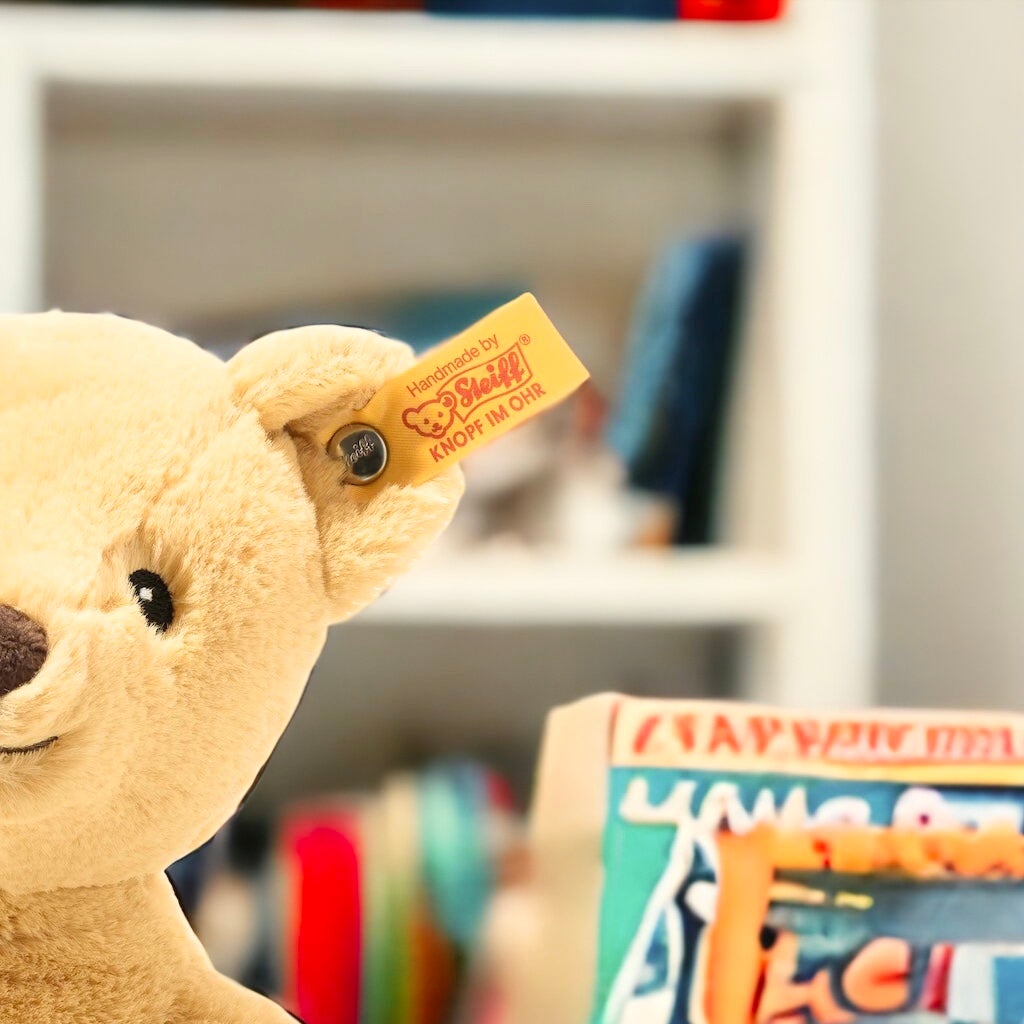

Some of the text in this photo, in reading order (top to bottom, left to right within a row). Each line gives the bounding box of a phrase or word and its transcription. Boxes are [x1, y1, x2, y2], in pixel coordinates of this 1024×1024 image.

[406, 334, 499, 397] Handmade by
[454, 350, 525, 408] Steiff
[429, 382, 547, 463] KNOPF IM OHR
